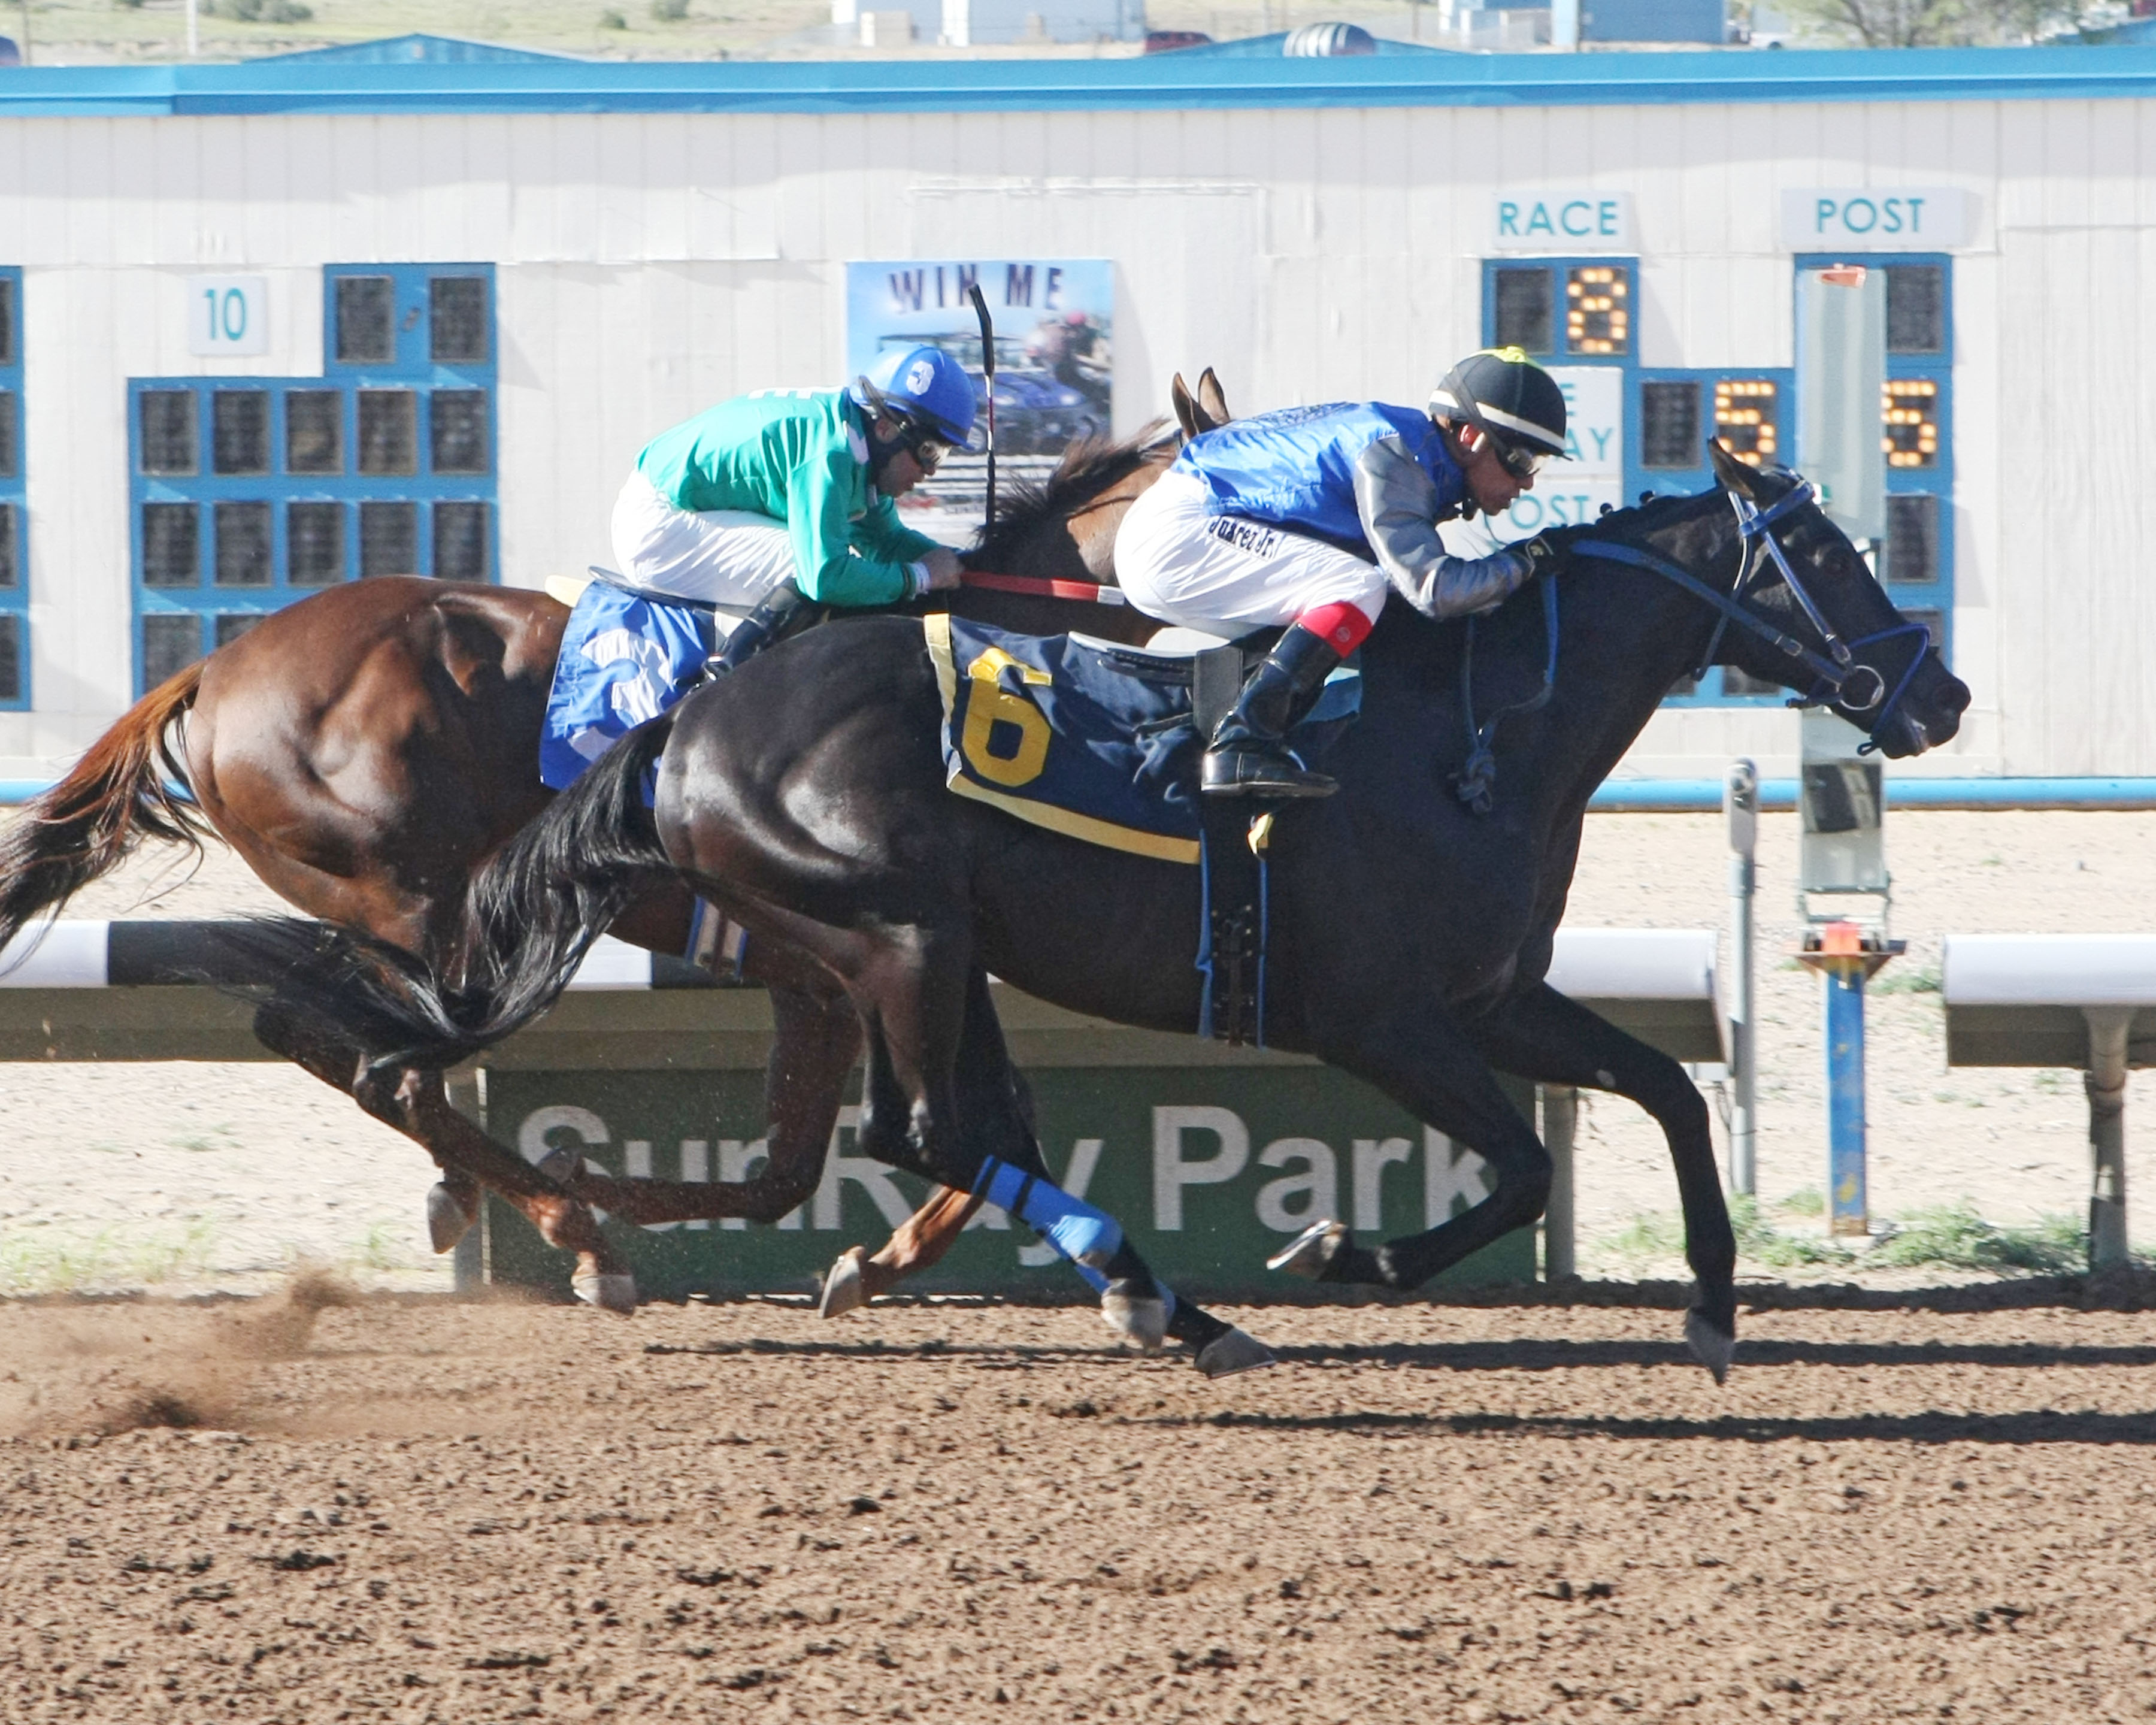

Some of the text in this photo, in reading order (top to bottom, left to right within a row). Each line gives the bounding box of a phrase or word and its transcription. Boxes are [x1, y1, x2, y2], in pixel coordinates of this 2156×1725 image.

[1499, 201, 1620, 236] RACE
[1816, 198, 1925, 233] POST
[889, 264, 1064, 313] WIN ME
[1567, 267, 1627, 353] 8
[204, 288, 247, 341] 10
[907, 361, 934, 395] 3
[1555, 428, 1613, 461] AY
[1715, 380, 1937, 467] 5 5
[1484, 494, 1590, 529] OST
[961, 646, 1052, 787] 6
[1152, 1105, 1491, 1233] Park
